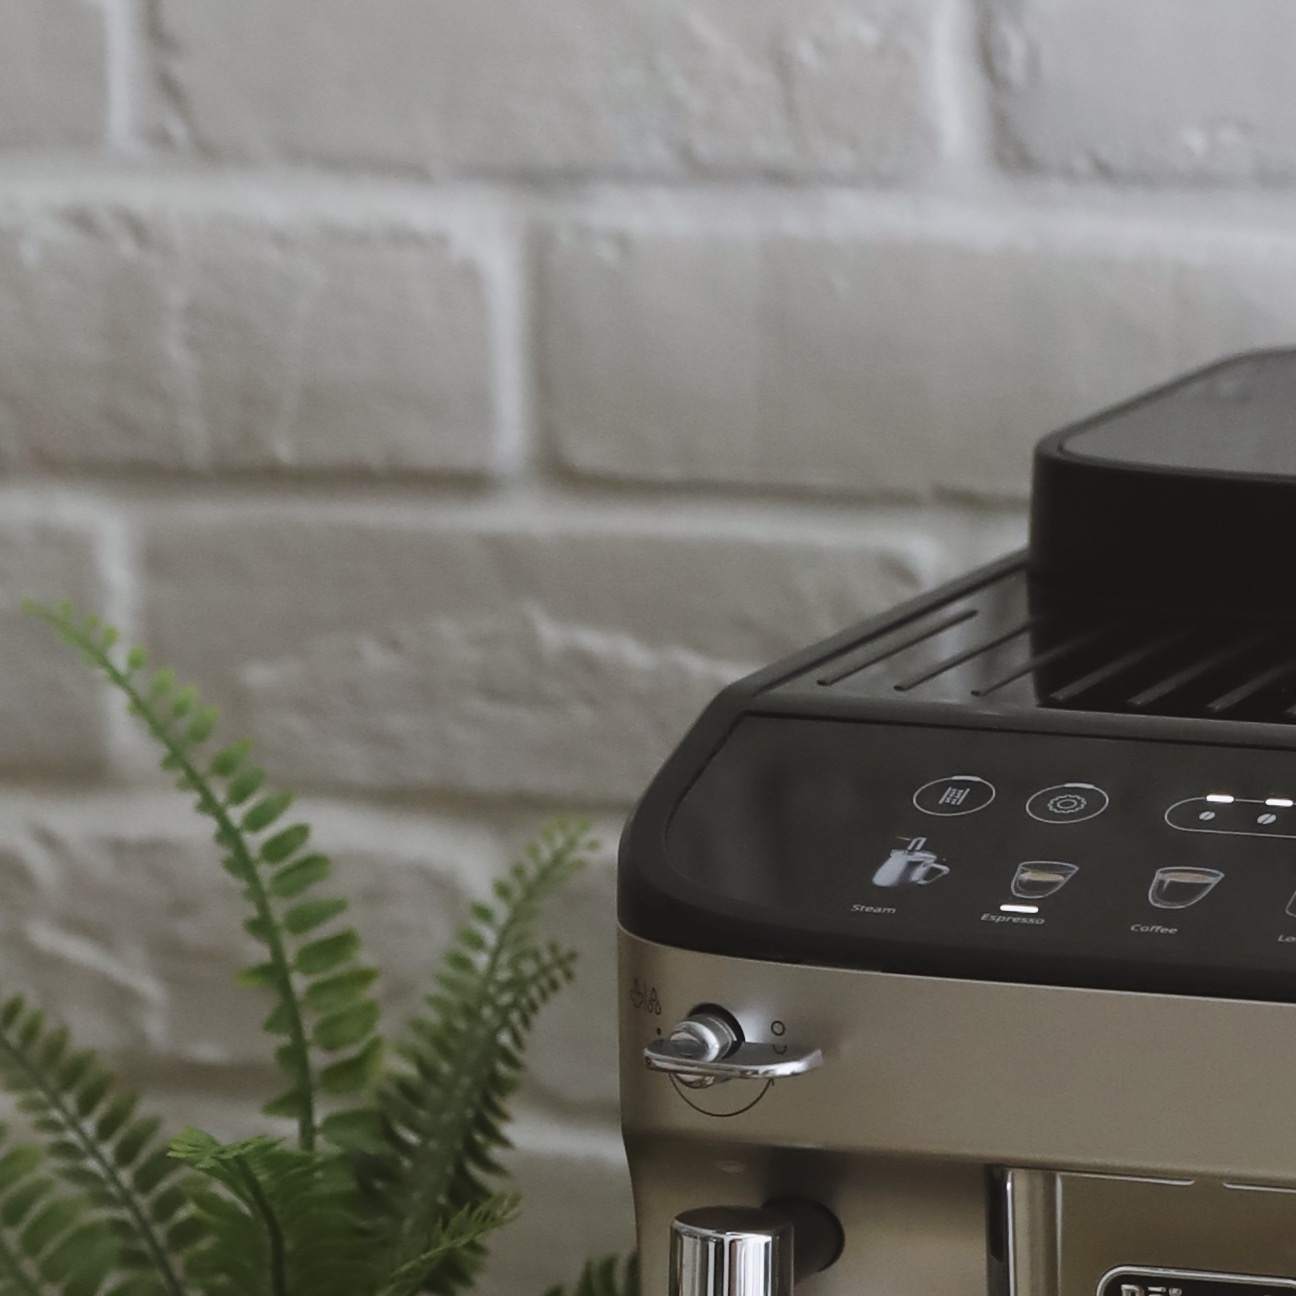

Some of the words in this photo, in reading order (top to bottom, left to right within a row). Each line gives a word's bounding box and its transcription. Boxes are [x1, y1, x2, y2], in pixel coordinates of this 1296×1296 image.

[850, 903, 897, 915] Steam
[980, 912, 1046, 926] Espresso
[1129, 923, 1179, 936] Coffee
